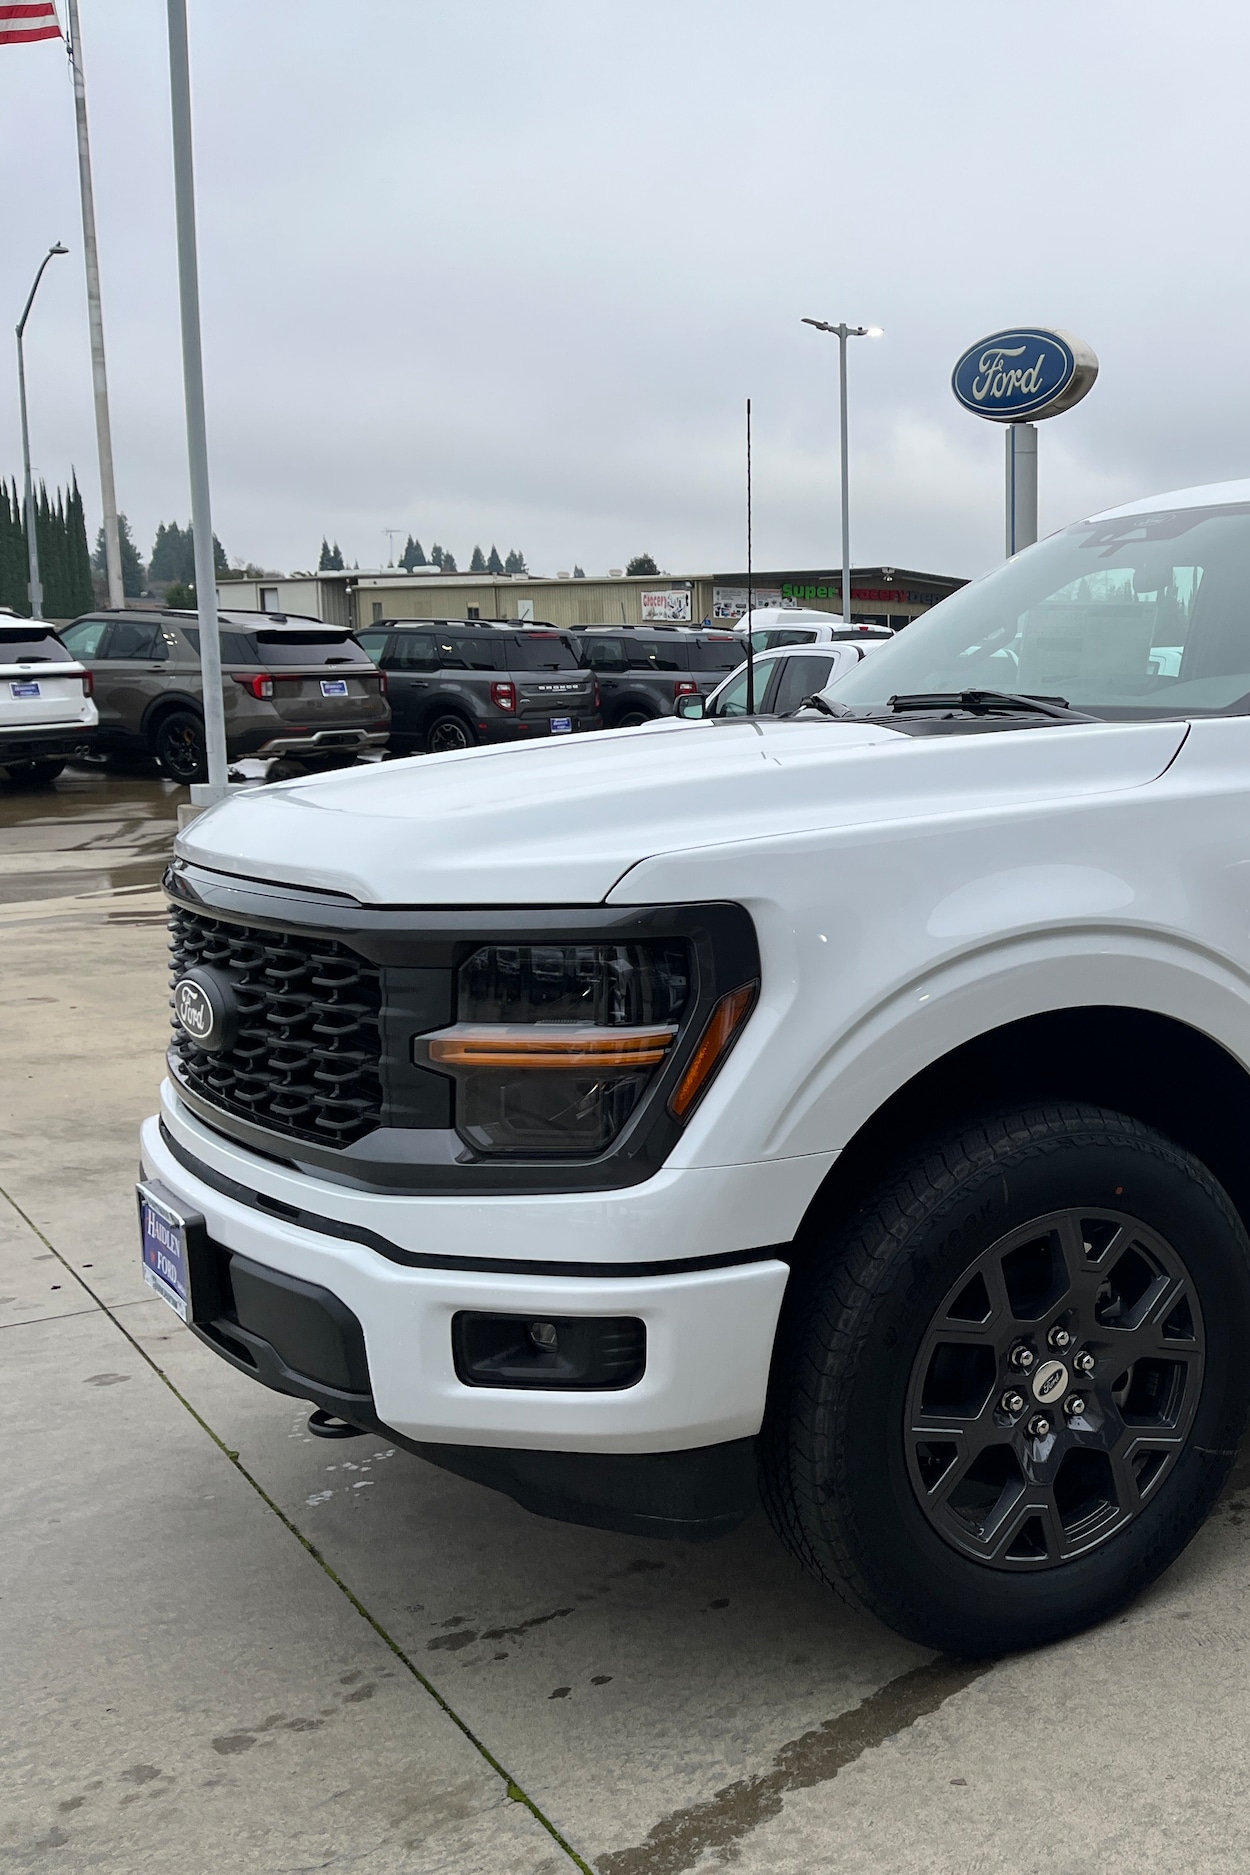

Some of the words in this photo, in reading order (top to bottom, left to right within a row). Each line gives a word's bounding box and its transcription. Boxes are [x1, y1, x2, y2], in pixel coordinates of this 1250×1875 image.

[972, 345, 1045, 401] Ford
[643, 594, 667, 609] Grocery
[782, 583, 836, 600] Super
[180, 986, 205, 1031] Ford
[147, 1209, 181, 1259] HAIDLEN
[157, 1250, 177, 1284] FORD
[1043, 1372, 1060, 1393] Ford
